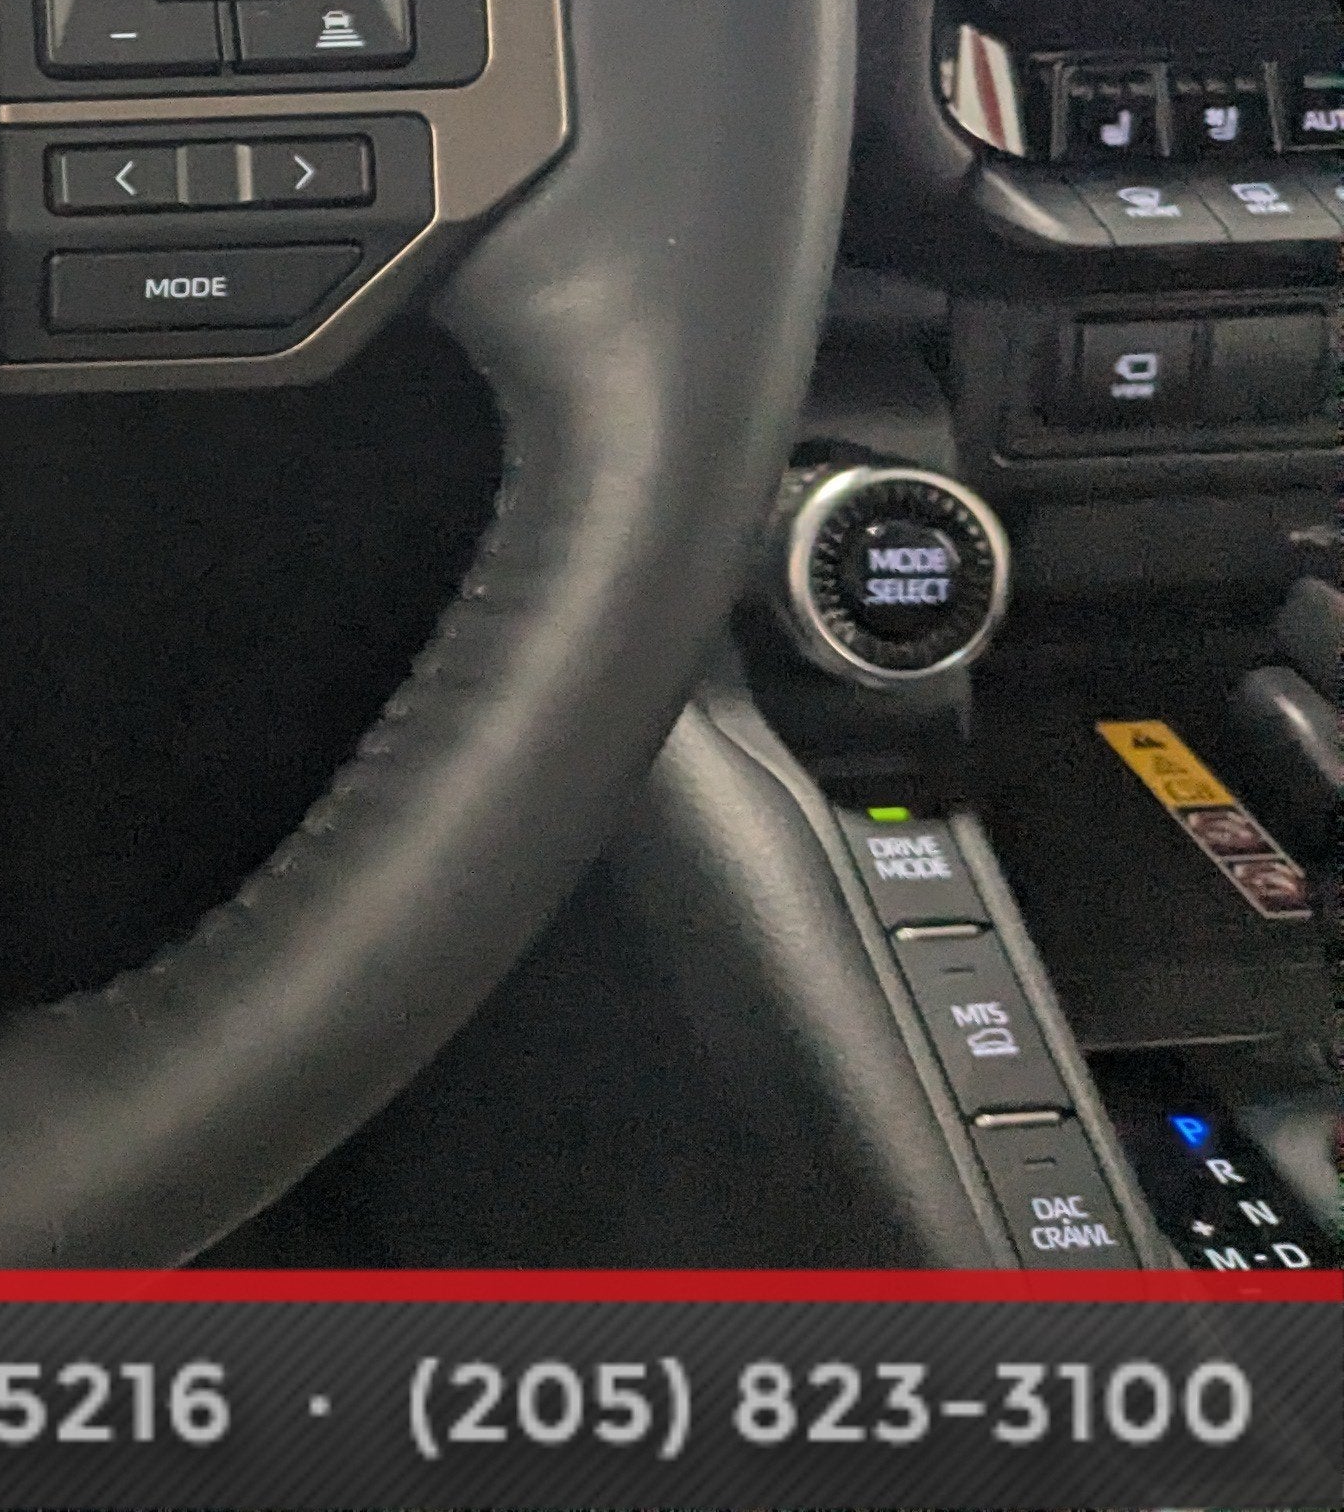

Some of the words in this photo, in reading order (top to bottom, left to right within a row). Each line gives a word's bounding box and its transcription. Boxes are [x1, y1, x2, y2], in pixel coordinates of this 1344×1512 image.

[145, 276, 229, 299] MODE
[868, 548, 947, 573] MODE
[863, 578, 950, 605] SELECT
[867, 836, 942, 859] DRIVE
[874, 857, 952, 880] MODE
[950, 1001, 1008, 1027] MTS
[1169, 1114, 1208, 1148] P
[1206, 1158, 1245, 1185] R
[1031, 1195, 1091, 1222] DAC
[1238, 1199, 1280, 1227] N
[1030, 1222, 1117, 1251] CRAWL
[1205, 1246, 1252, 1271] M
[1272, 1242, 1313, 1270] D
